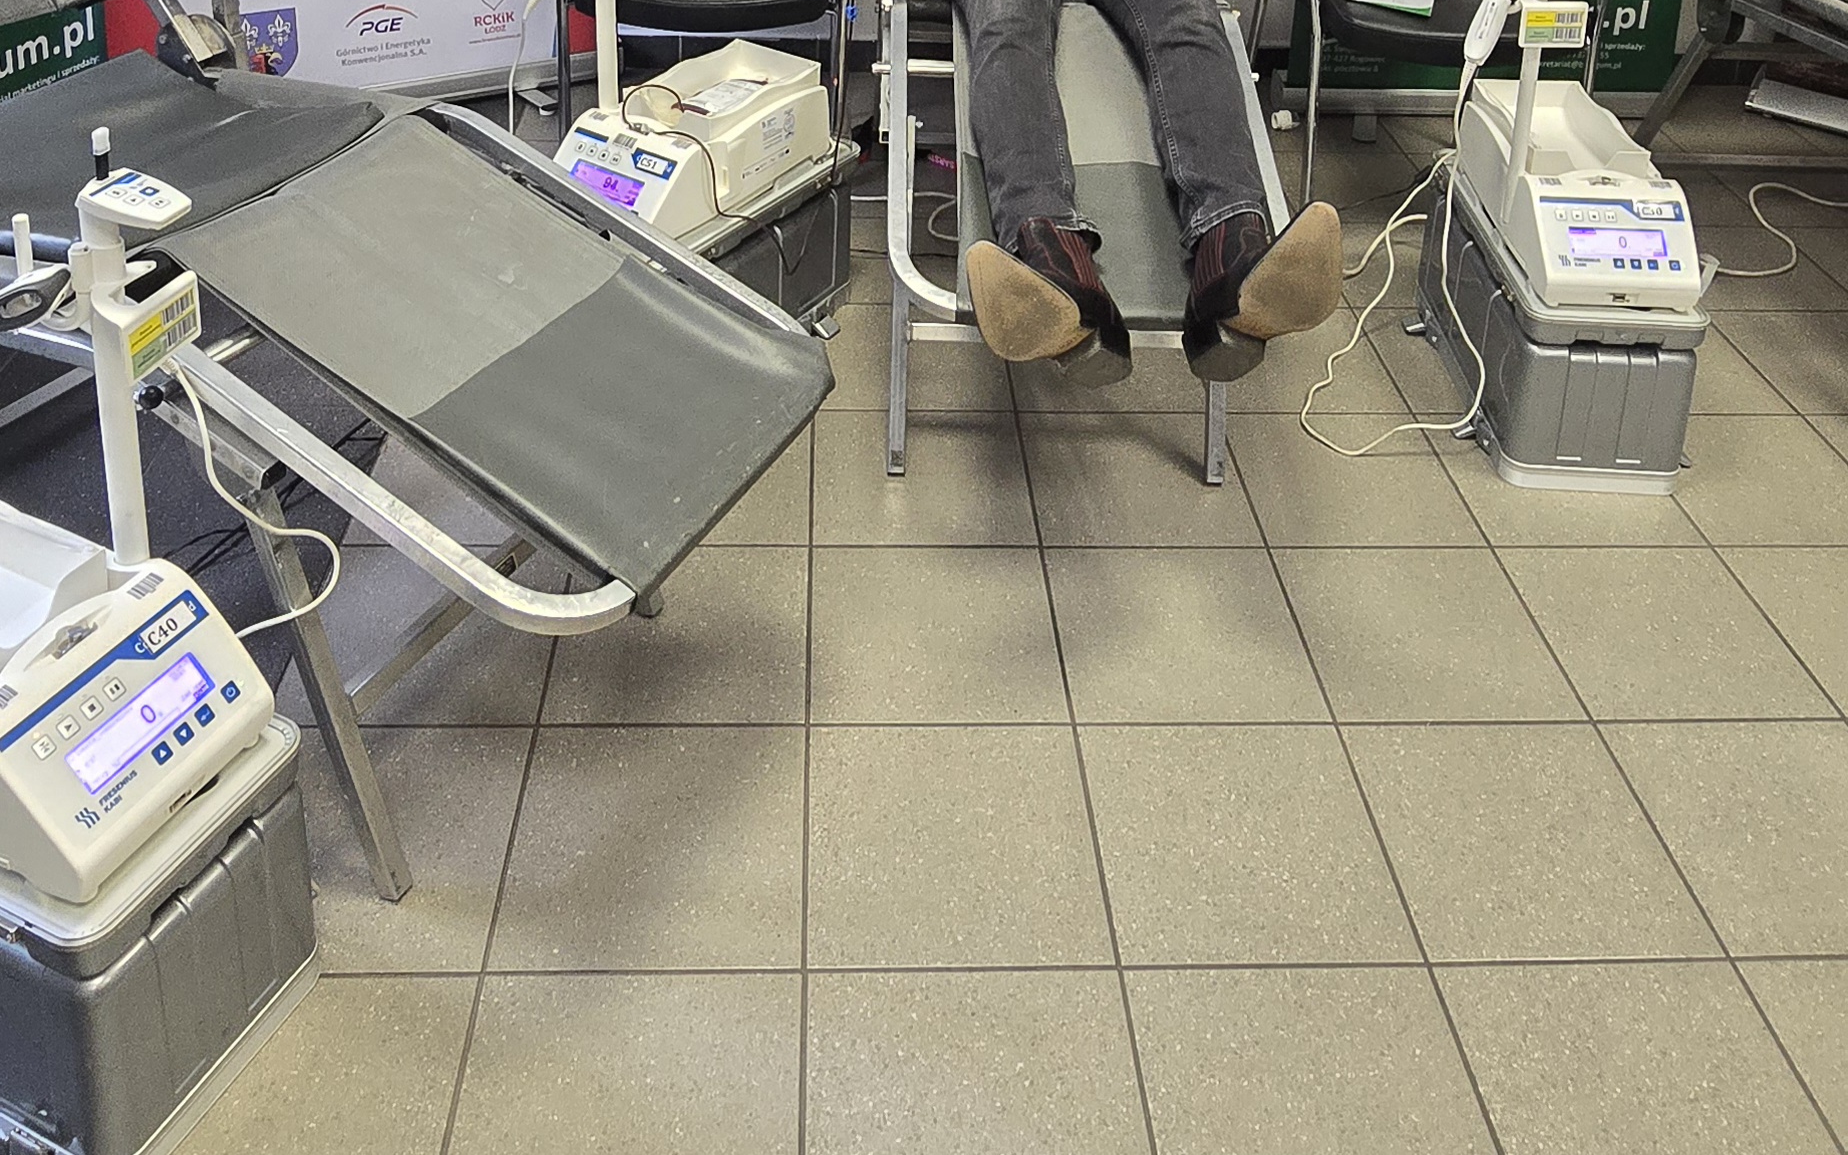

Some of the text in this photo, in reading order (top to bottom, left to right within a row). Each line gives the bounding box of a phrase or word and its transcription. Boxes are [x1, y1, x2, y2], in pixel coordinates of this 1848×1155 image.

[359, 17, 403, 36] PGE
[473, 11, 515, 27] RCKiK
[336, 44, 379, 57] Górnictwo
[385, 37, 431, 51] Energetyka
[341, 47, 427, 66] Konwencjonalna S.A.
[147, 617, 178, 646] C40
[140, 704, 156, 723] 0
[99, 769, 138, 806] FRESENIUS
[103, 795, 123, 814] KABI
